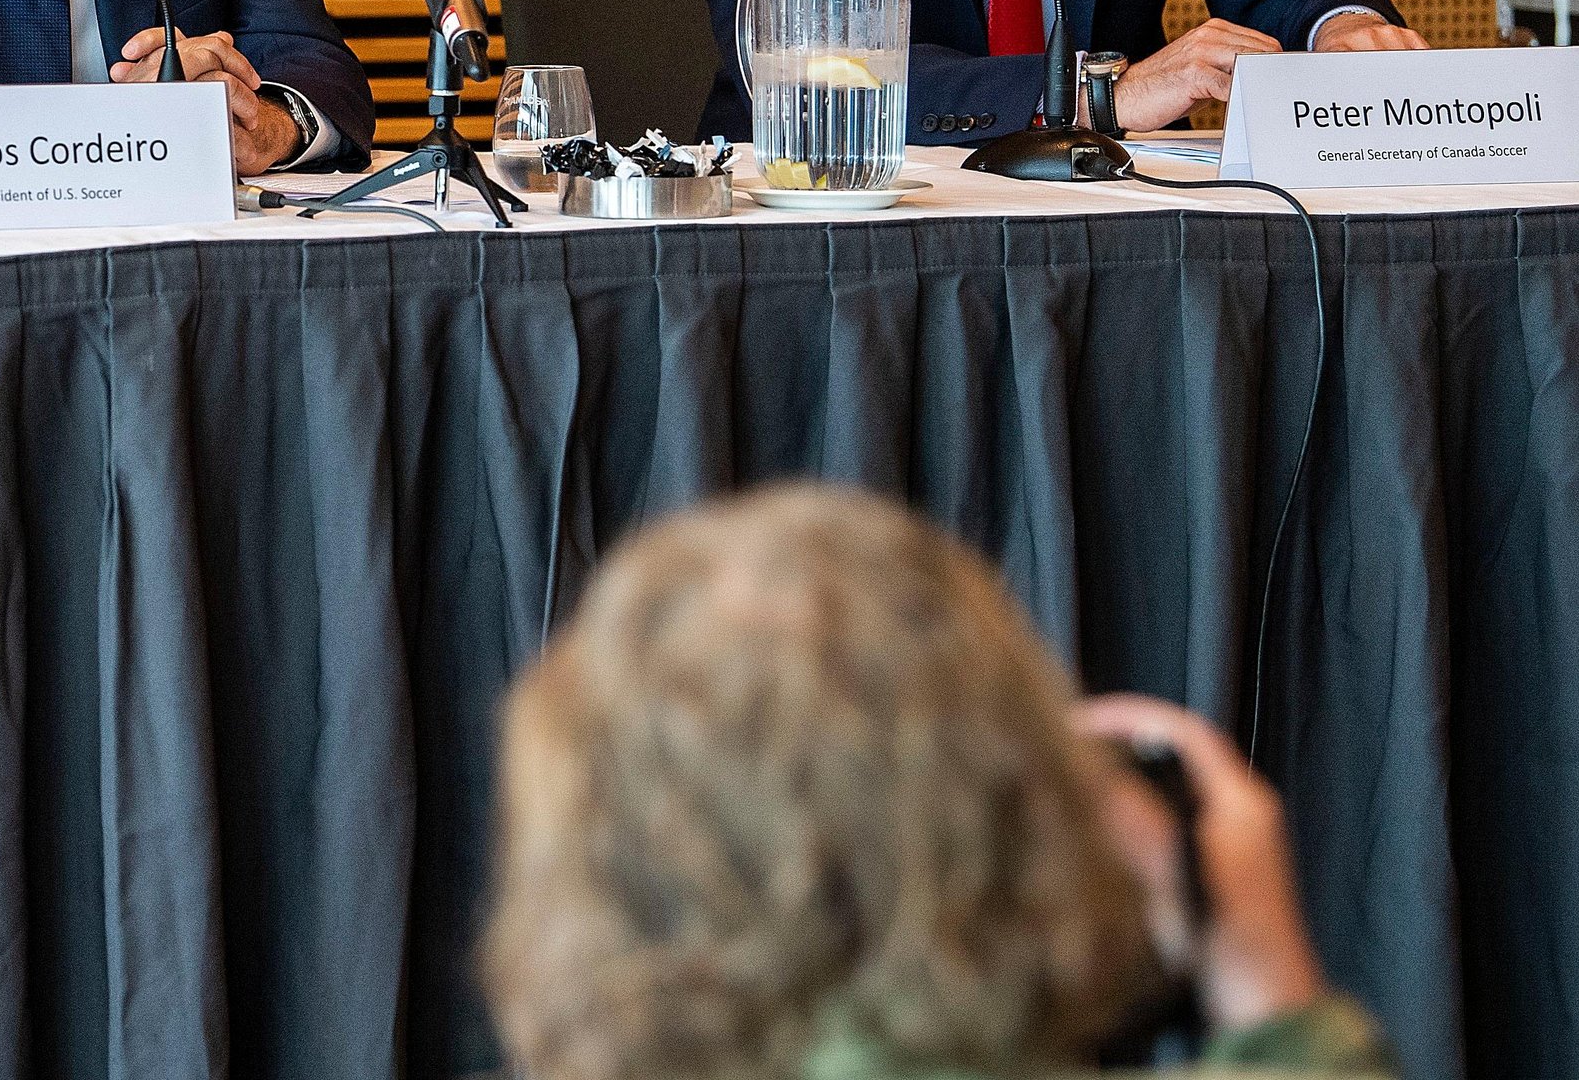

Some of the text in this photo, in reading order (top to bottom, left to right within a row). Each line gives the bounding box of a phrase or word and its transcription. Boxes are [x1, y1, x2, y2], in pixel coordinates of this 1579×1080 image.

[1293, 92, 1542, 131] Peter Montopoli
[29, 132, 169, 166] Cordeiro
[1317, 145, 1529, 162] General Secretary of Canada Soccer
[36, 187, 50, 201] of
[52, 187, 79, 201] U.S.
[81, 187, 124, 200] Soccer
